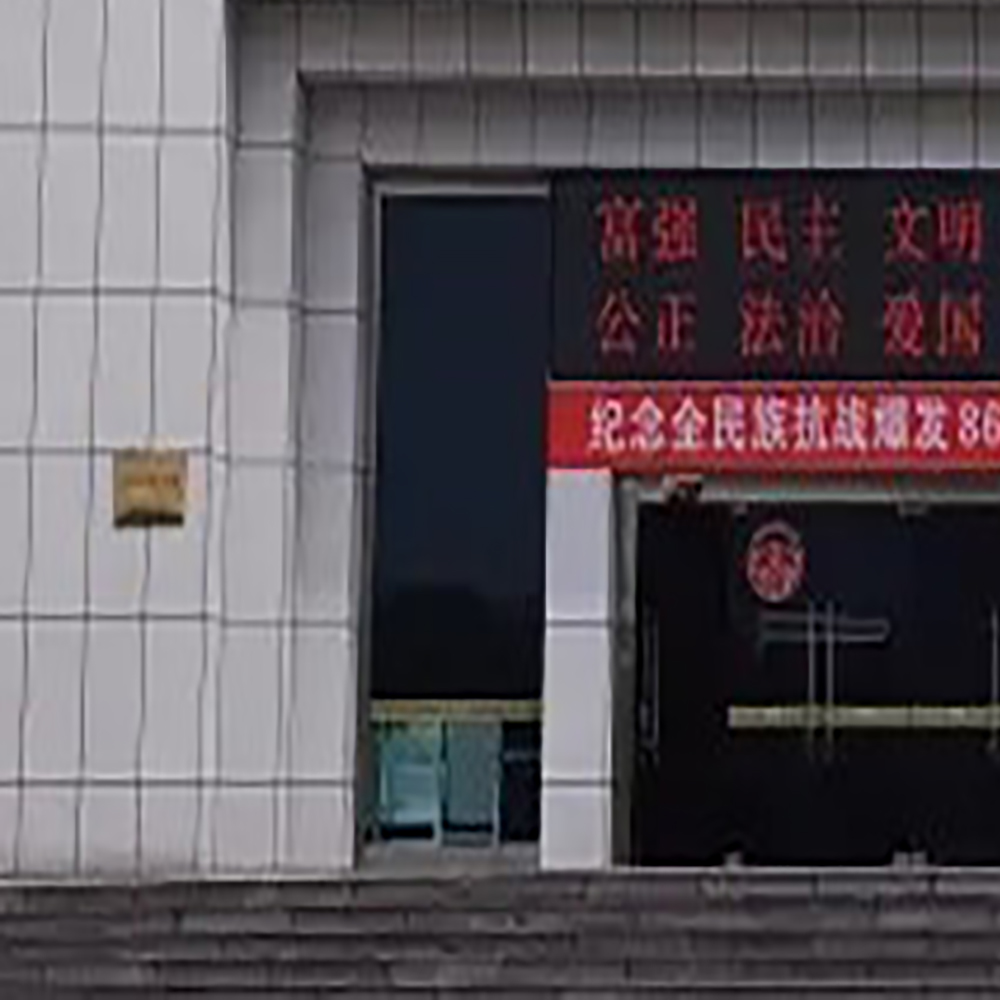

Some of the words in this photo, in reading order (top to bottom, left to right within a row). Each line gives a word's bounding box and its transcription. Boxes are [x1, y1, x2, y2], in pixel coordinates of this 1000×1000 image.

[597, 195, 697, 262] 富强
[739, 195, 842, 263] 民主
[883, 197, 983, 262] 文明
[598, 290, 697, 354] 公正
[739, 290, 842, 356] 法治
